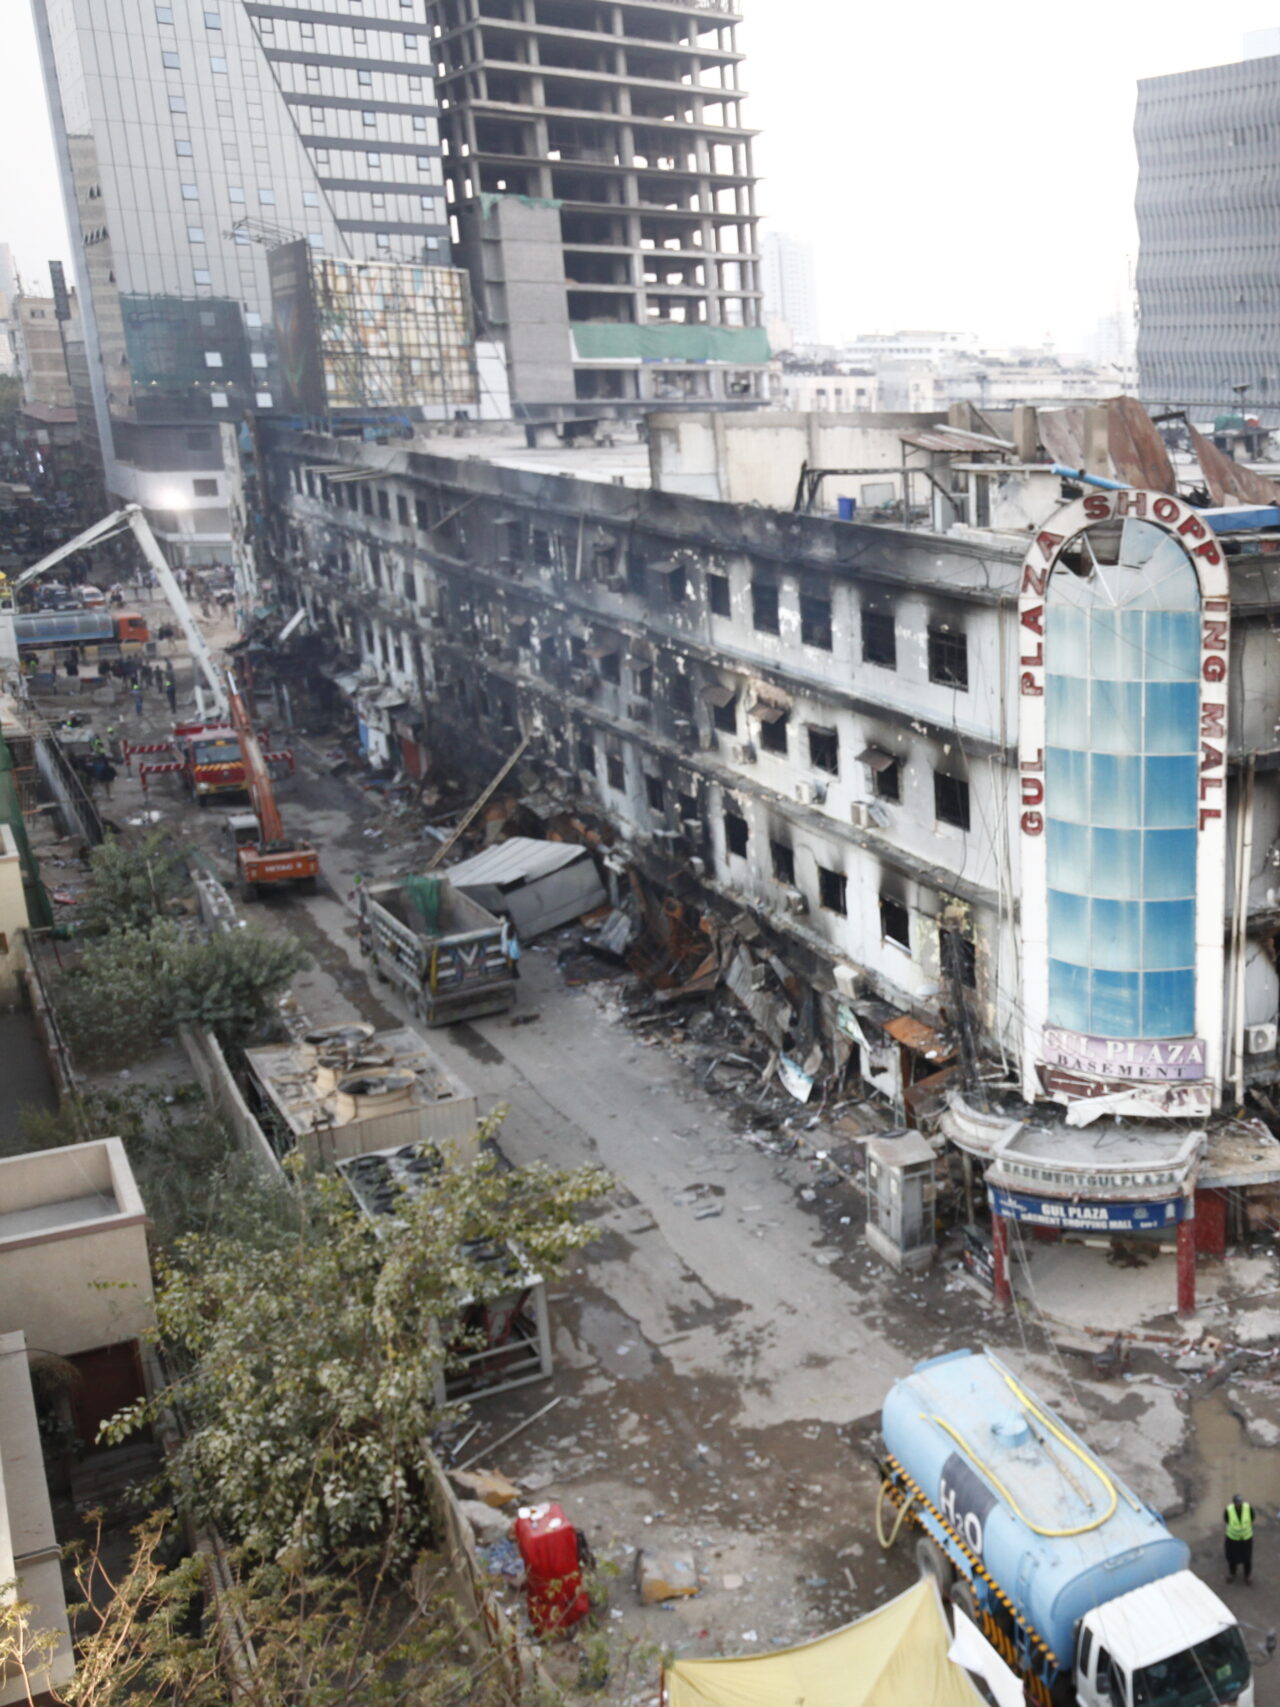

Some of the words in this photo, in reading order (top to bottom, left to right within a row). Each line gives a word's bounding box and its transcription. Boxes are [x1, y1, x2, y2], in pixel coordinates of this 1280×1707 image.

[1020, 530, 1065, 697] PLAZA
[1020, 748, 1044, 837] GUL
[1199, 702, 1225, 832] MALL
[1057, 1053, 1188, 1078] BASEMENT
[1105, 1039, 1204, 1065] PLAZA
[1041, 1203, 1066, 1219] GUL
[1067, 1206, 1109, 1220] PLAZA
